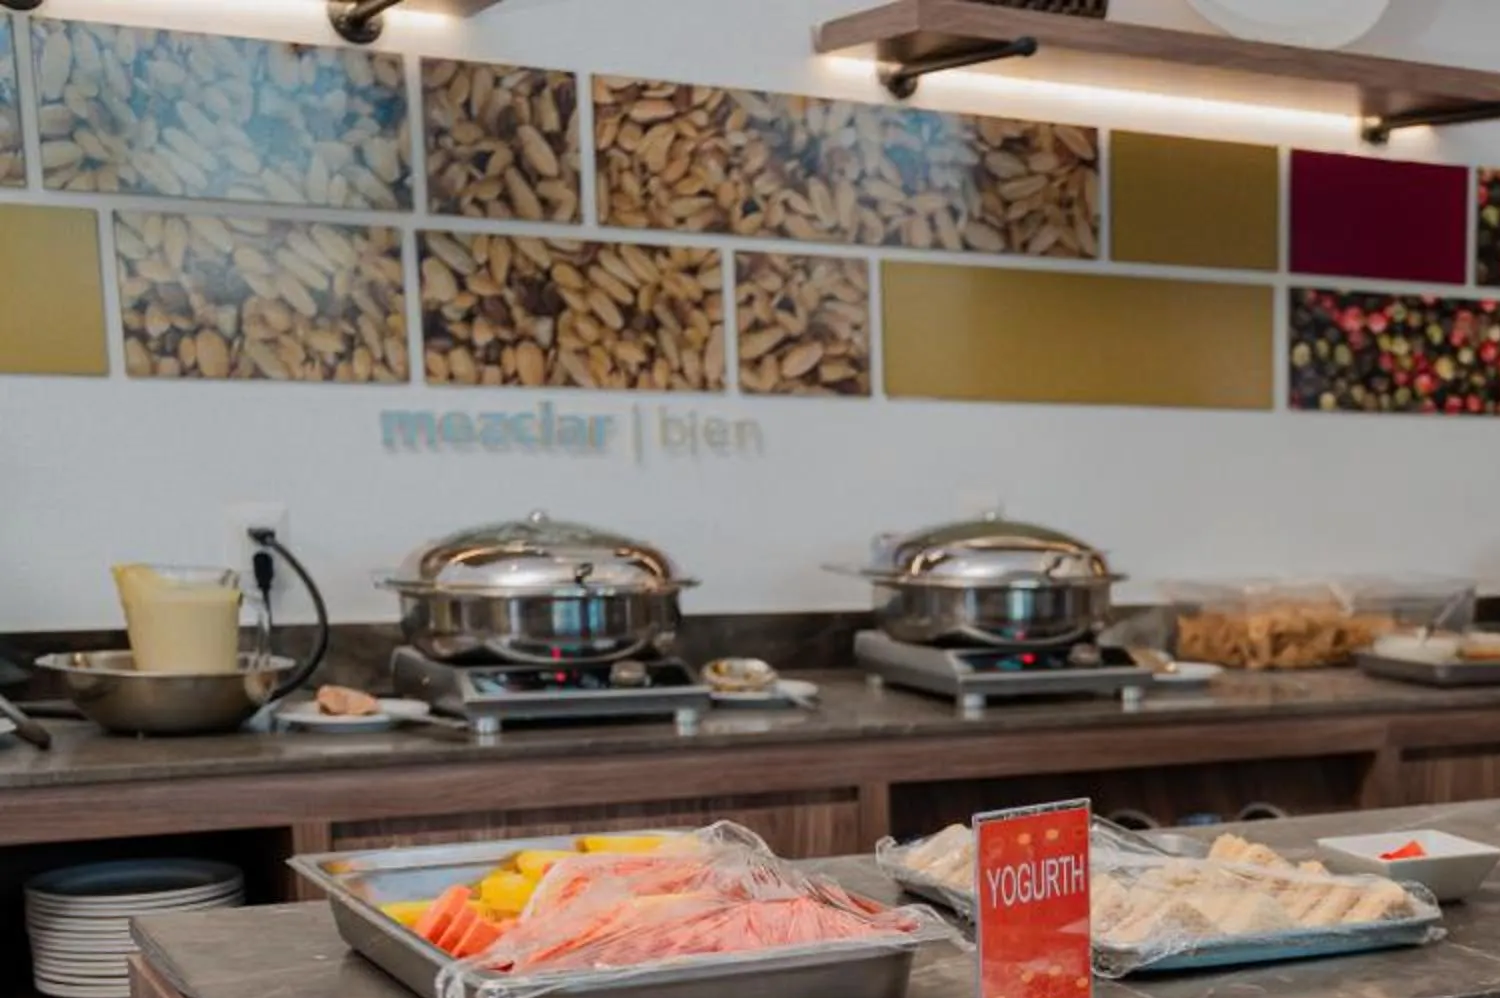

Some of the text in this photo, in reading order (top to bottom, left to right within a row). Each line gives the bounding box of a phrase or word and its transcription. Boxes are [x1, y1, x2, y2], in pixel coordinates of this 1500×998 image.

[379, 401, 766, 456] mezclar bien
[986, 853, 1086, 909] YOGURTH
